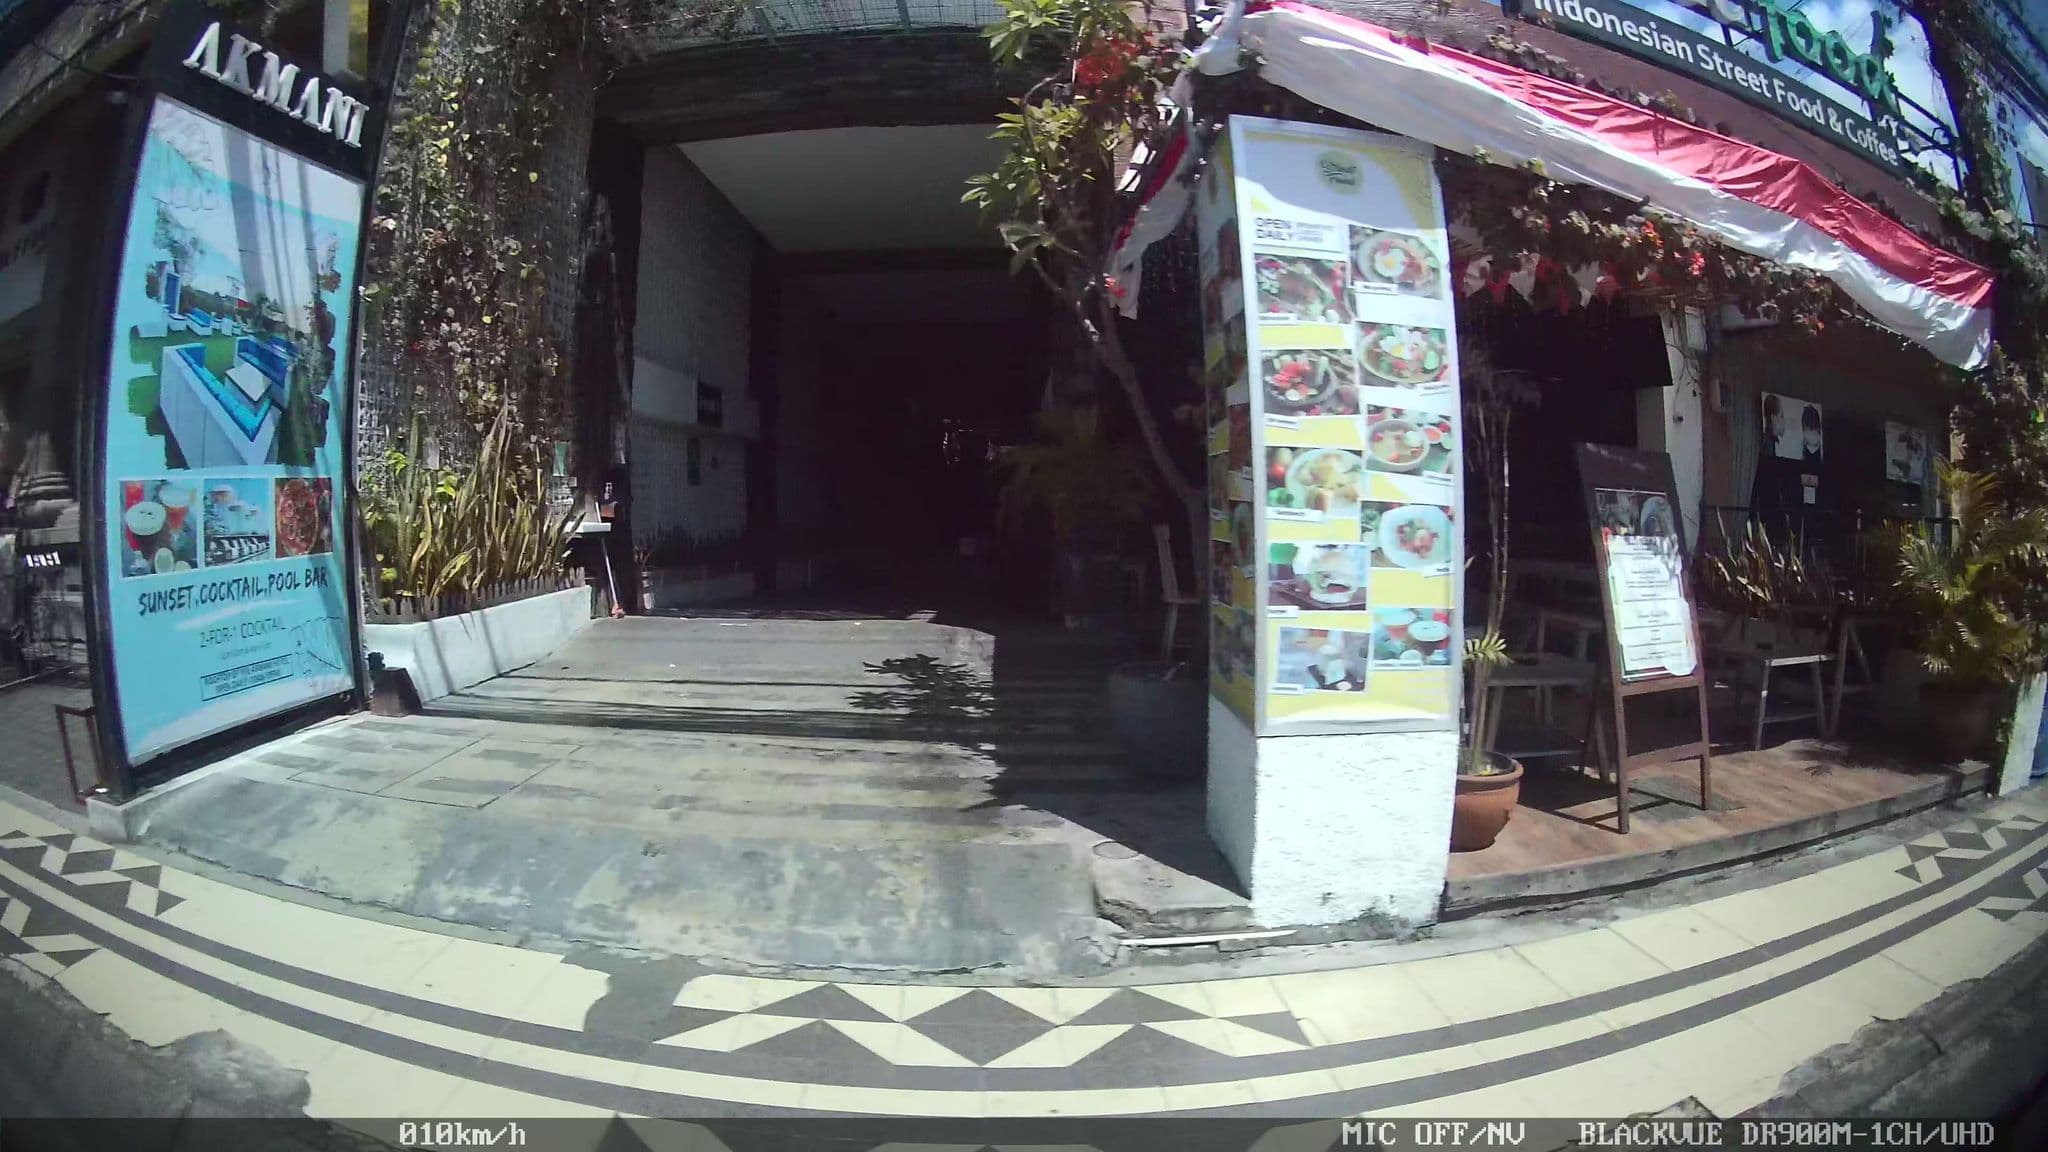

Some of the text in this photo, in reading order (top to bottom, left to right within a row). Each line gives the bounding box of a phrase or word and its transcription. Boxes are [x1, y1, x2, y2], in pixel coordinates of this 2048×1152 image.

[182, 21, 370, 148] AKMANI
[1697, 43, 1772, 98] Street
[1772, 77, 1825, 126] Food
[1827, 107, 1844, 136] &
[1845, 118, 1899, 167] Coffee
[1255, 217, 1292, 230] OPEN
[1255, 228, 1293, 241] DAILY
[304, 566, 328, 588] BAR
